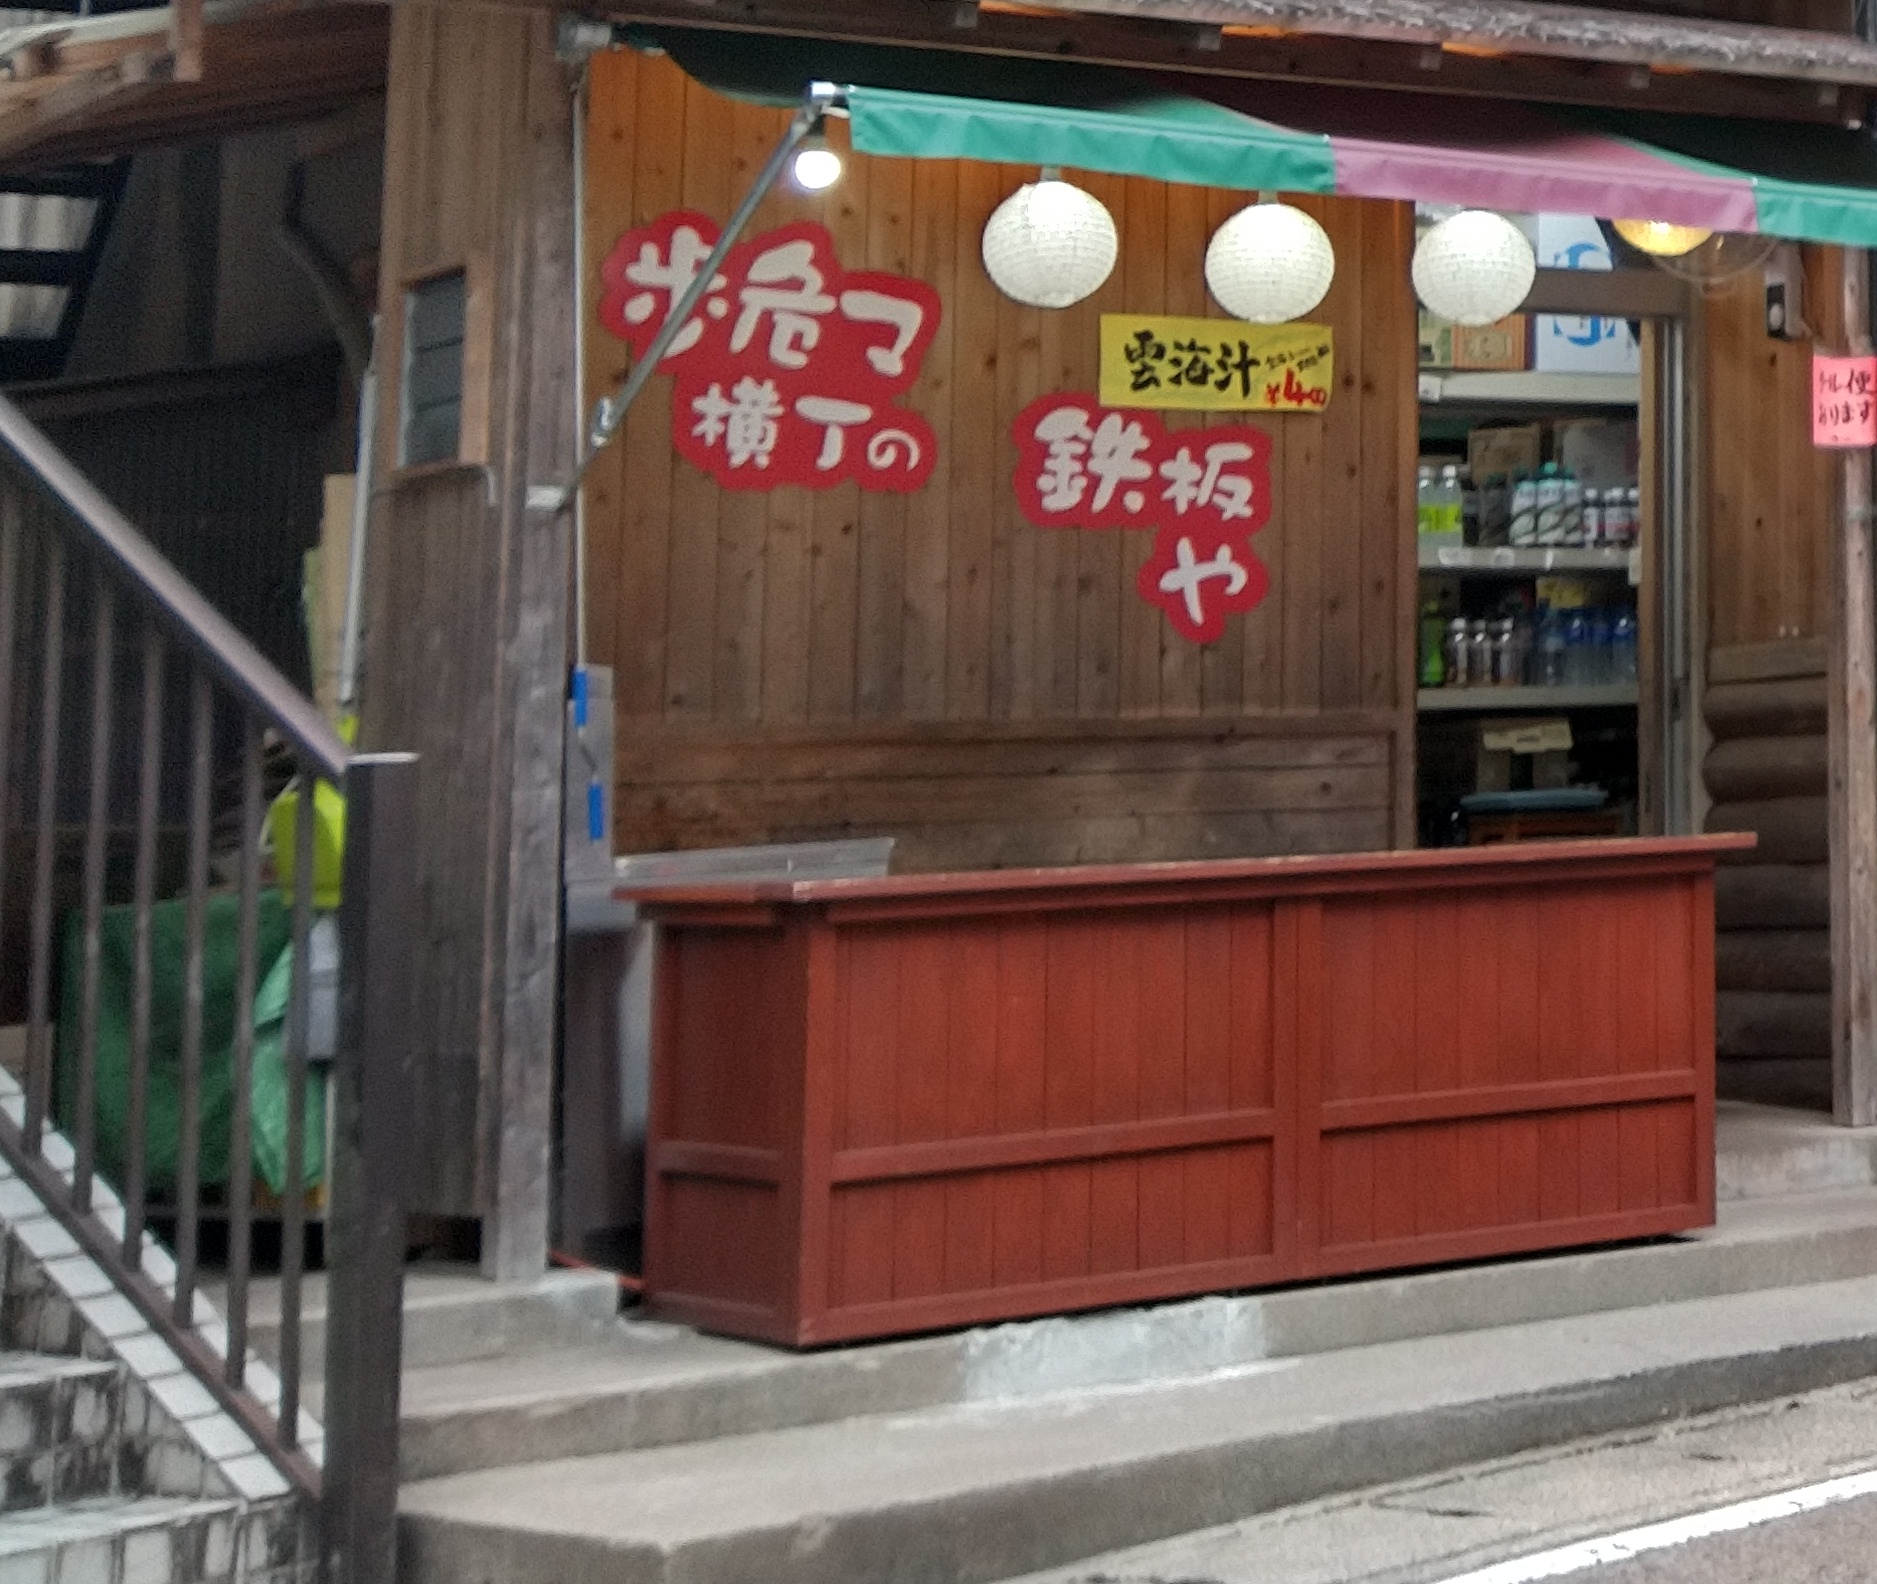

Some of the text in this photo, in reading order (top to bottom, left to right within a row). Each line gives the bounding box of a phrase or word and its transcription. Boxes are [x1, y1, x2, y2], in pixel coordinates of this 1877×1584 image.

[1123, 327, 1261, 402] 雲海汁
[691, 376, 922, 471] 横丁の
[1034, 408, 1255, 521] 鉄板
[1158, 536, 1248, 627] や
